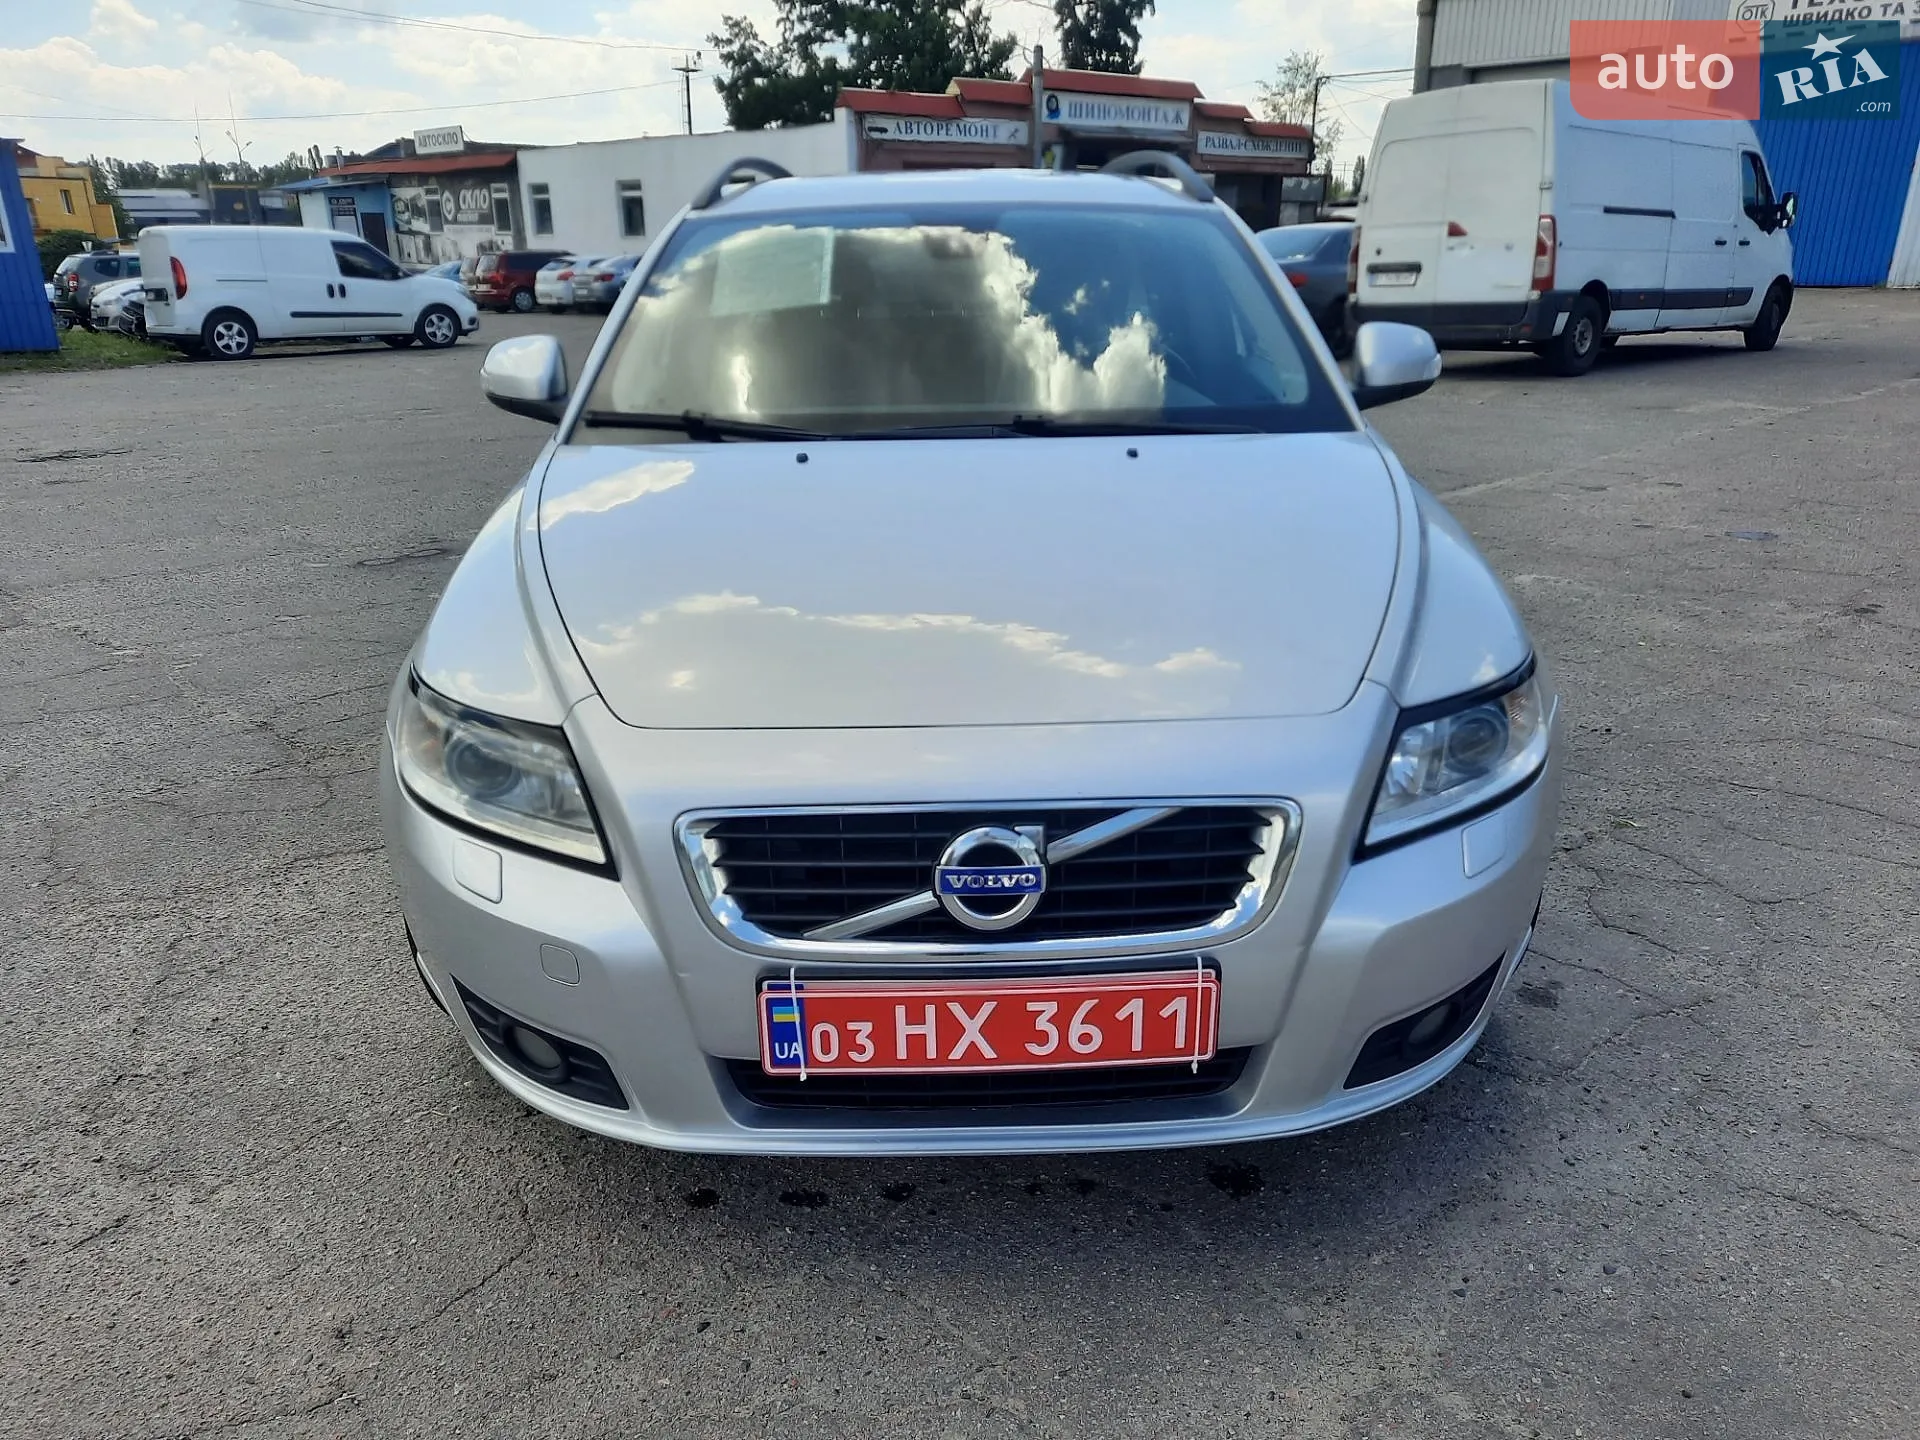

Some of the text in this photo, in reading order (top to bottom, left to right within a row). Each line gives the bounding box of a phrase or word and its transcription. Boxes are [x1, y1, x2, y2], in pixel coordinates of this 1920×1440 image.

[1783, 5, 1872, 28] ШВИДКО
[1881, 2, 1905, 17] ТА
[1067, 101, 1184, 125] ШИНОМОНТАЖ
[418, 131, 459, 147] АВТОСКЛО
[893, 120, 999, 139] АВТОРЕМОНТ
[946, 873, 1036, 889] VOLVO
[811, 1022, 875, 1063] 03
[1024, 996, 1188, 1057] 3611
[775, 1042, 800, 1059] UA
